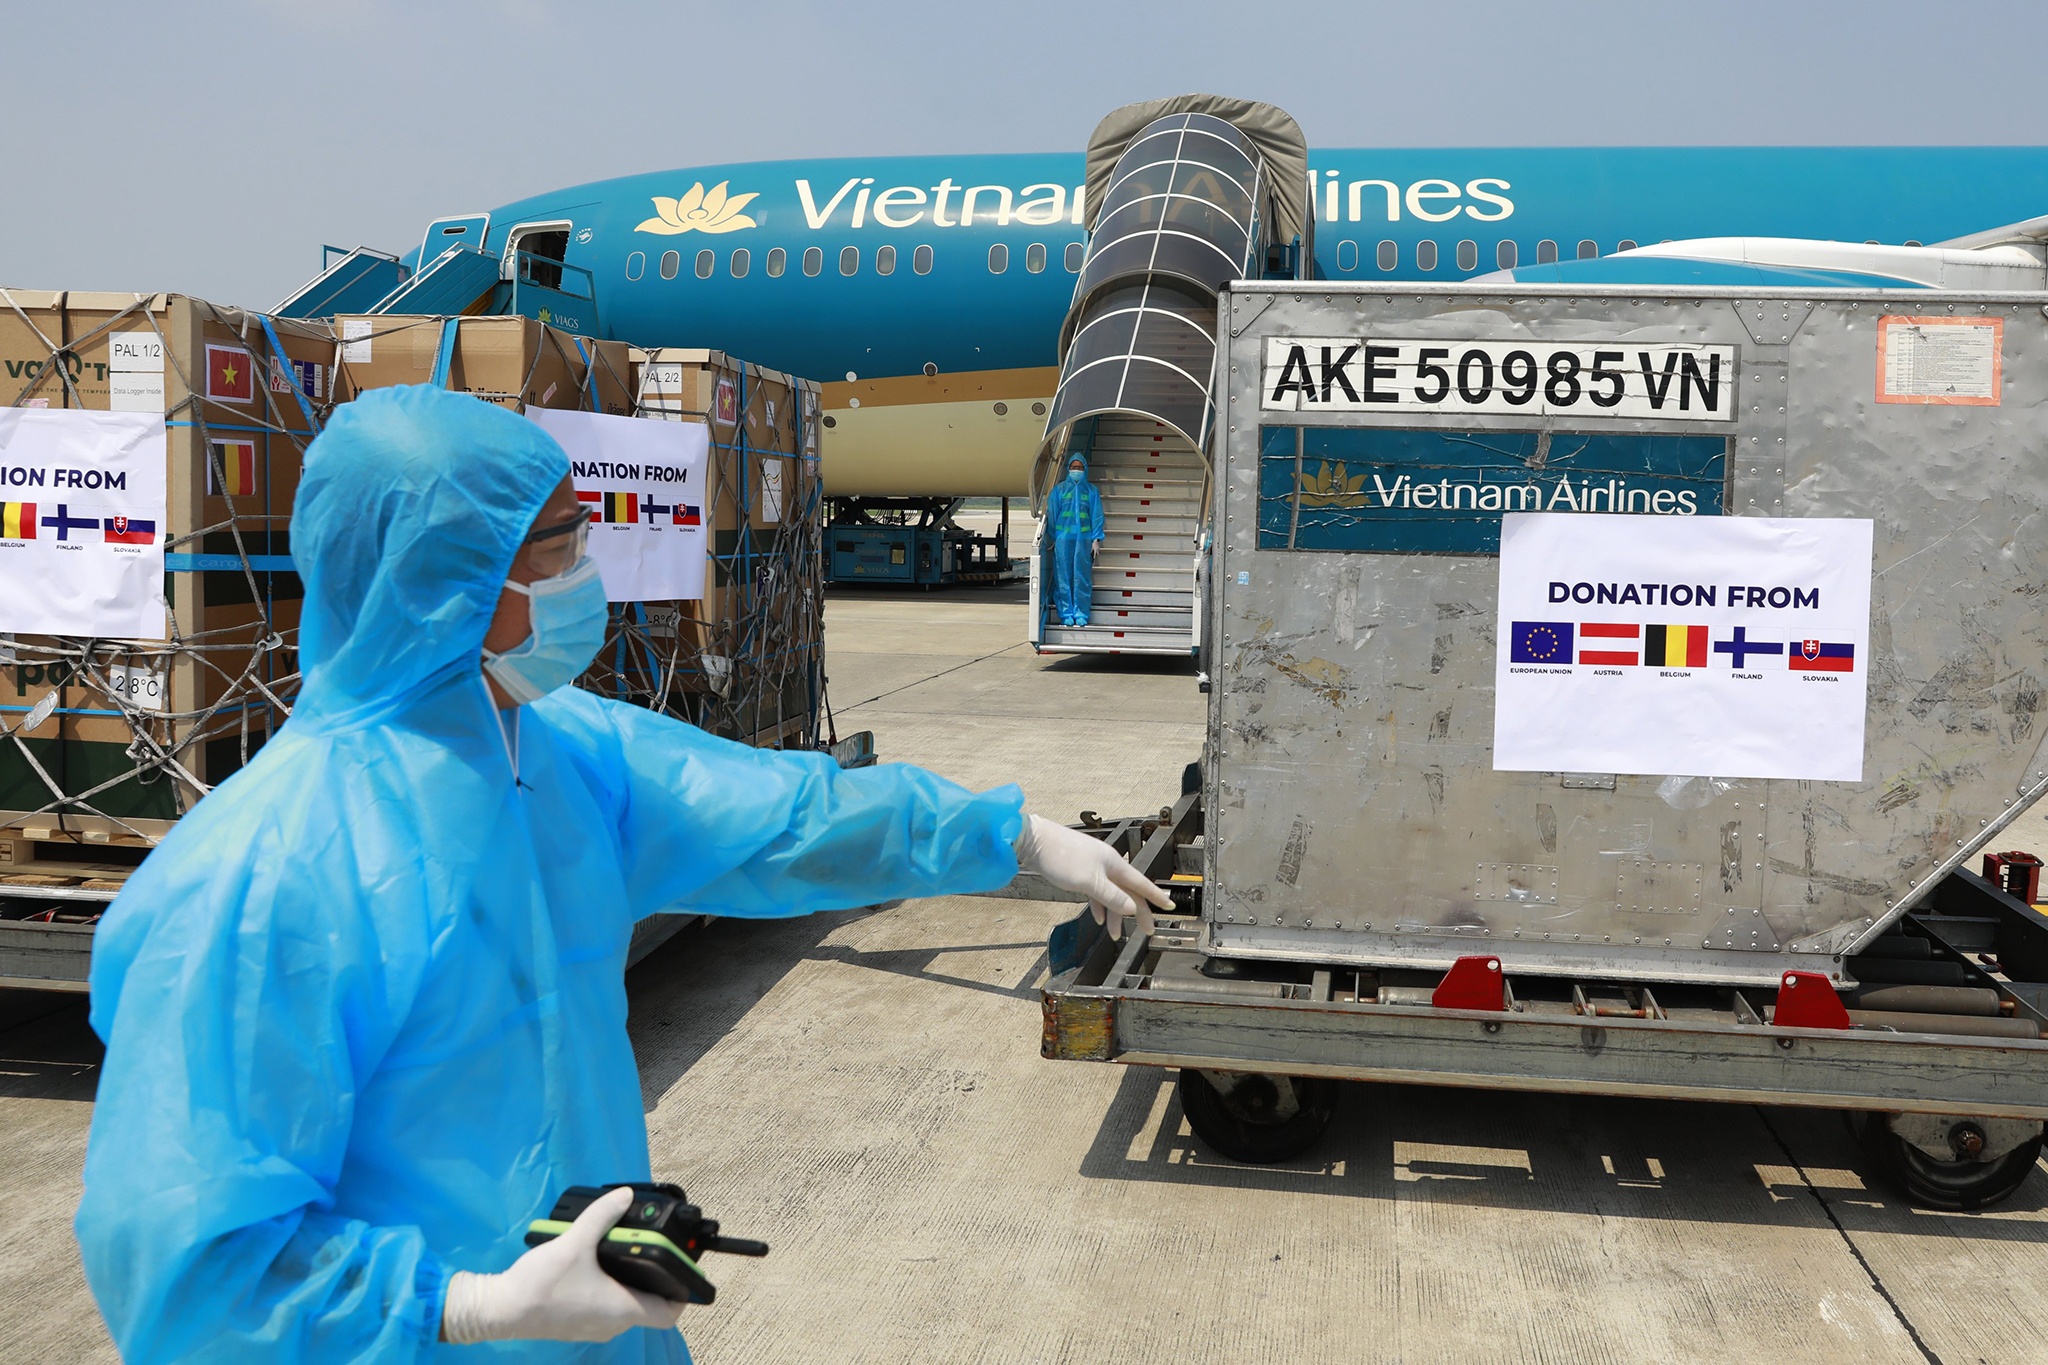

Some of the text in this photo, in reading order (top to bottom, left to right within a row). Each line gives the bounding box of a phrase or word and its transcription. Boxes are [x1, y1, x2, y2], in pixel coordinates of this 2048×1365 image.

[554, 313, 579, 330] VIAGS
[114, 343, 161, 358] PAL 1/2
[664, 373, 680, 384] 2/2
[1270, 345, 1720, 412] AKE 50985 VN
[113, 387, 126, 395] Data
[126, 387, 145, 397] Logger
[54, 468, 127, 491] FROM
[570, 461, 688, 483] NATION FROM
[1372, 473, 1698, 516] Vietnam Airlines
[113, 546, 142, 554] SLOVAKIA
[1548, 581, 1820, 610] DONATION FROM
[1510, 667, 1549, 675] EUROPEAN
[1802, 675, 1839, 683] SLOVAKIA
